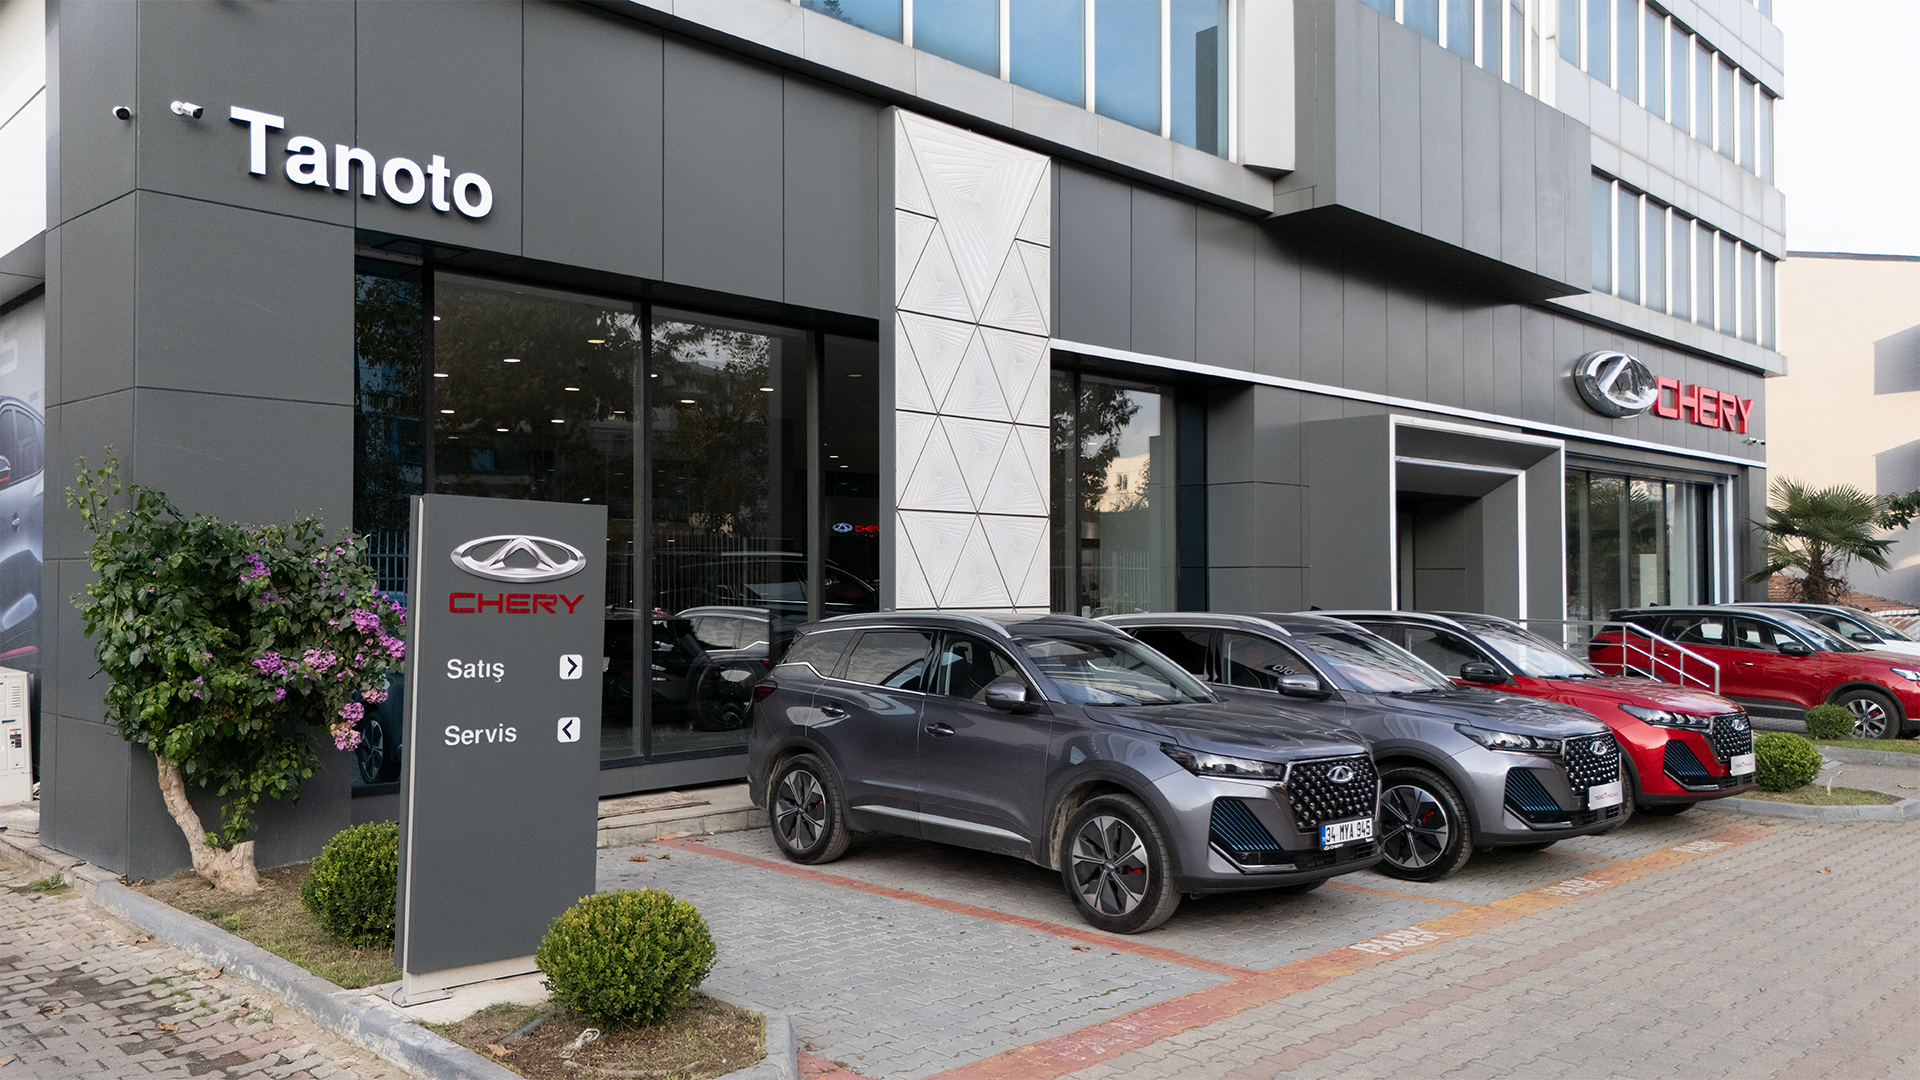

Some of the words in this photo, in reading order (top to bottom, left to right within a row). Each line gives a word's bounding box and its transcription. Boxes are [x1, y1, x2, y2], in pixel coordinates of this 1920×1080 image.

[229, 105, 494, 218] Tanoto
[1653, 375, 1755, 434] CHERY
[449, 592, 585, 614] CHERY
[447, 658, 505, 683] Satış
[444, 723, 517, 746] Servis
[1326, 827, 1336, 843] 34
[1340, 823, 1354, 840] MYA
[1357, 820, 1371, 837] 945
[1349, 926, 1451, 955] PARK
